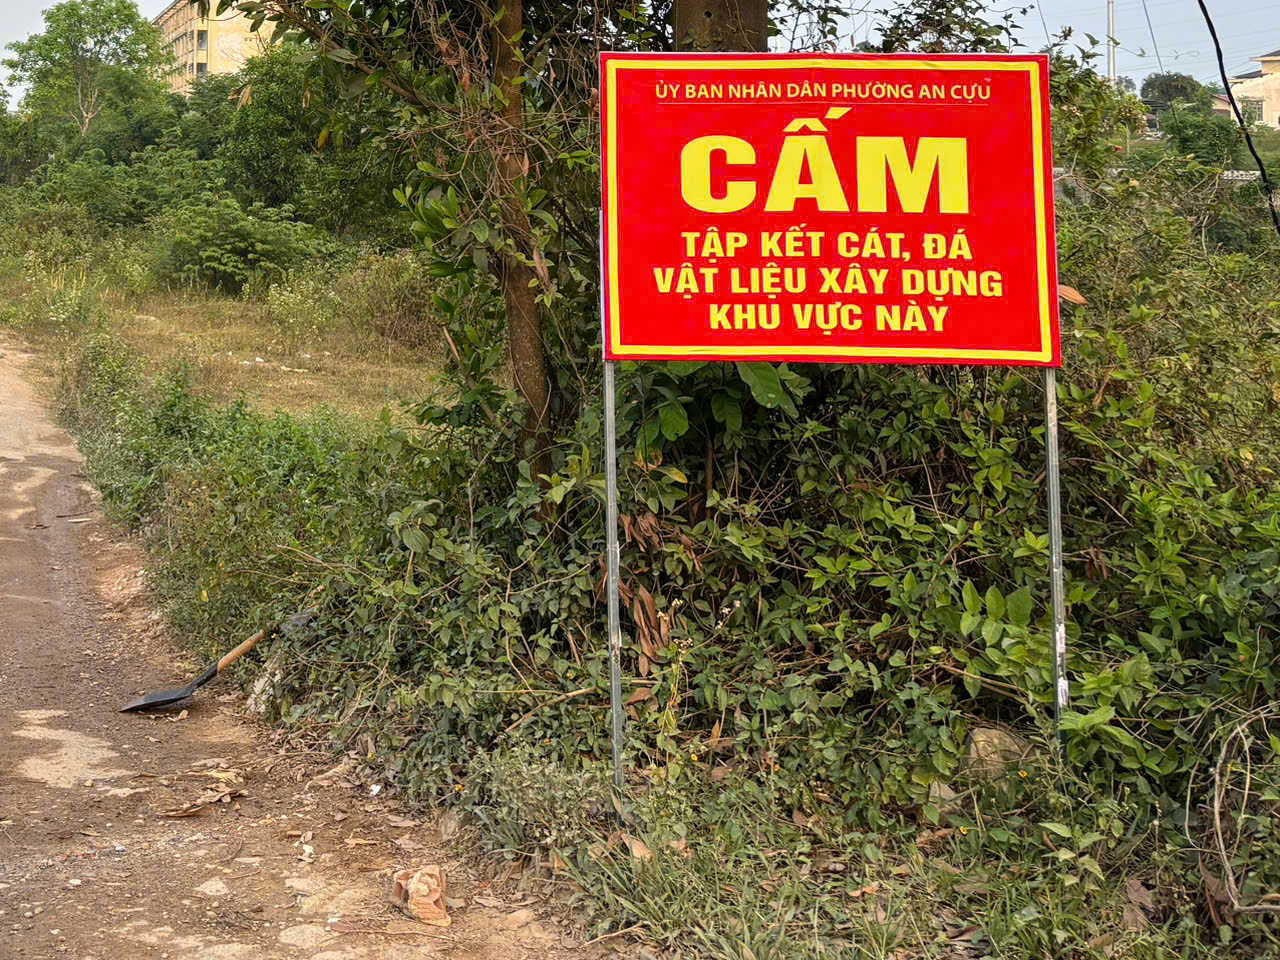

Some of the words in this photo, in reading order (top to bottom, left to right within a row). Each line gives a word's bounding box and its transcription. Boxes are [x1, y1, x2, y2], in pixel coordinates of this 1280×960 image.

[685, 84, 723, 99] BAN
[728, 80, 782, 99] NHÂN
[787, 79, 827, 98] DÂN
[831, 81, 914, 99] PHƯỜNG
[918, 84, 945, 99] AN
[680, 107, 969, 214] CẤM
[681, 226, 748, 264] TẬP
[761, 223, 825, 257] KẾT
[837, 226, 911, 262] CÁT,
[922, 228, 973, 260] ĐÁ
[653, 262, 719, 300] VẬT
[730, 262, 807, 299] LIỆU
[819, 263, 889, 295] XÂY
[901, 268, 1003, 302] DỰNG
[709, 303, 781, 330] KHU
[791, 301, 863, 336] VỰC
[875, 299, 949, 332] NÀY
